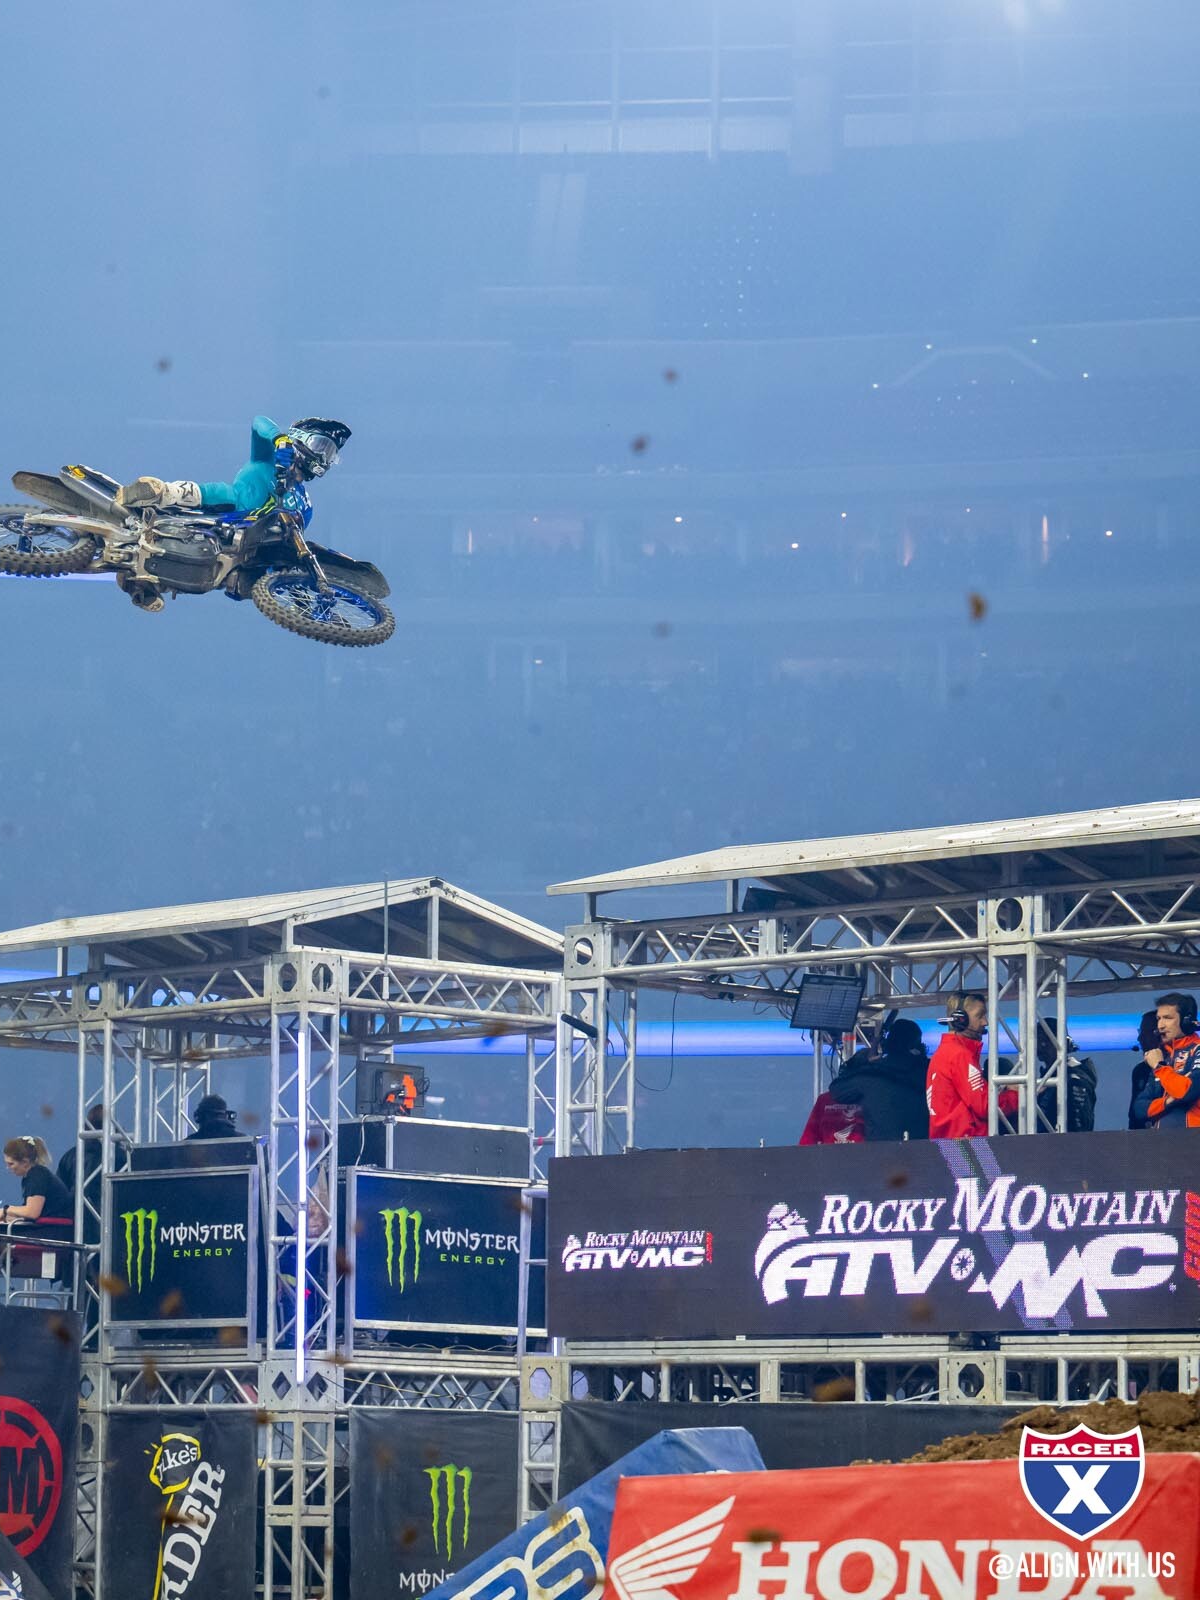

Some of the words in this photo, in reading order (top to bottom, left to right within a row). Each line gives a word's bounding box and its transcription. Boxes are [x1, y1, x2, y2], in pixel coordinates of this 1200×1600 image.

[815, 1194, 947, 1235] ROCKY
[584, 1231, 630, 1247] ROCKY
[631, 1230, 706, 1247] MOUNTAIN
[173, 1247, 233, 1258] ENERGY
[440, 1253, 506, 1266] ENERGY
[727, 1538, 1178, 1600] HONDA
